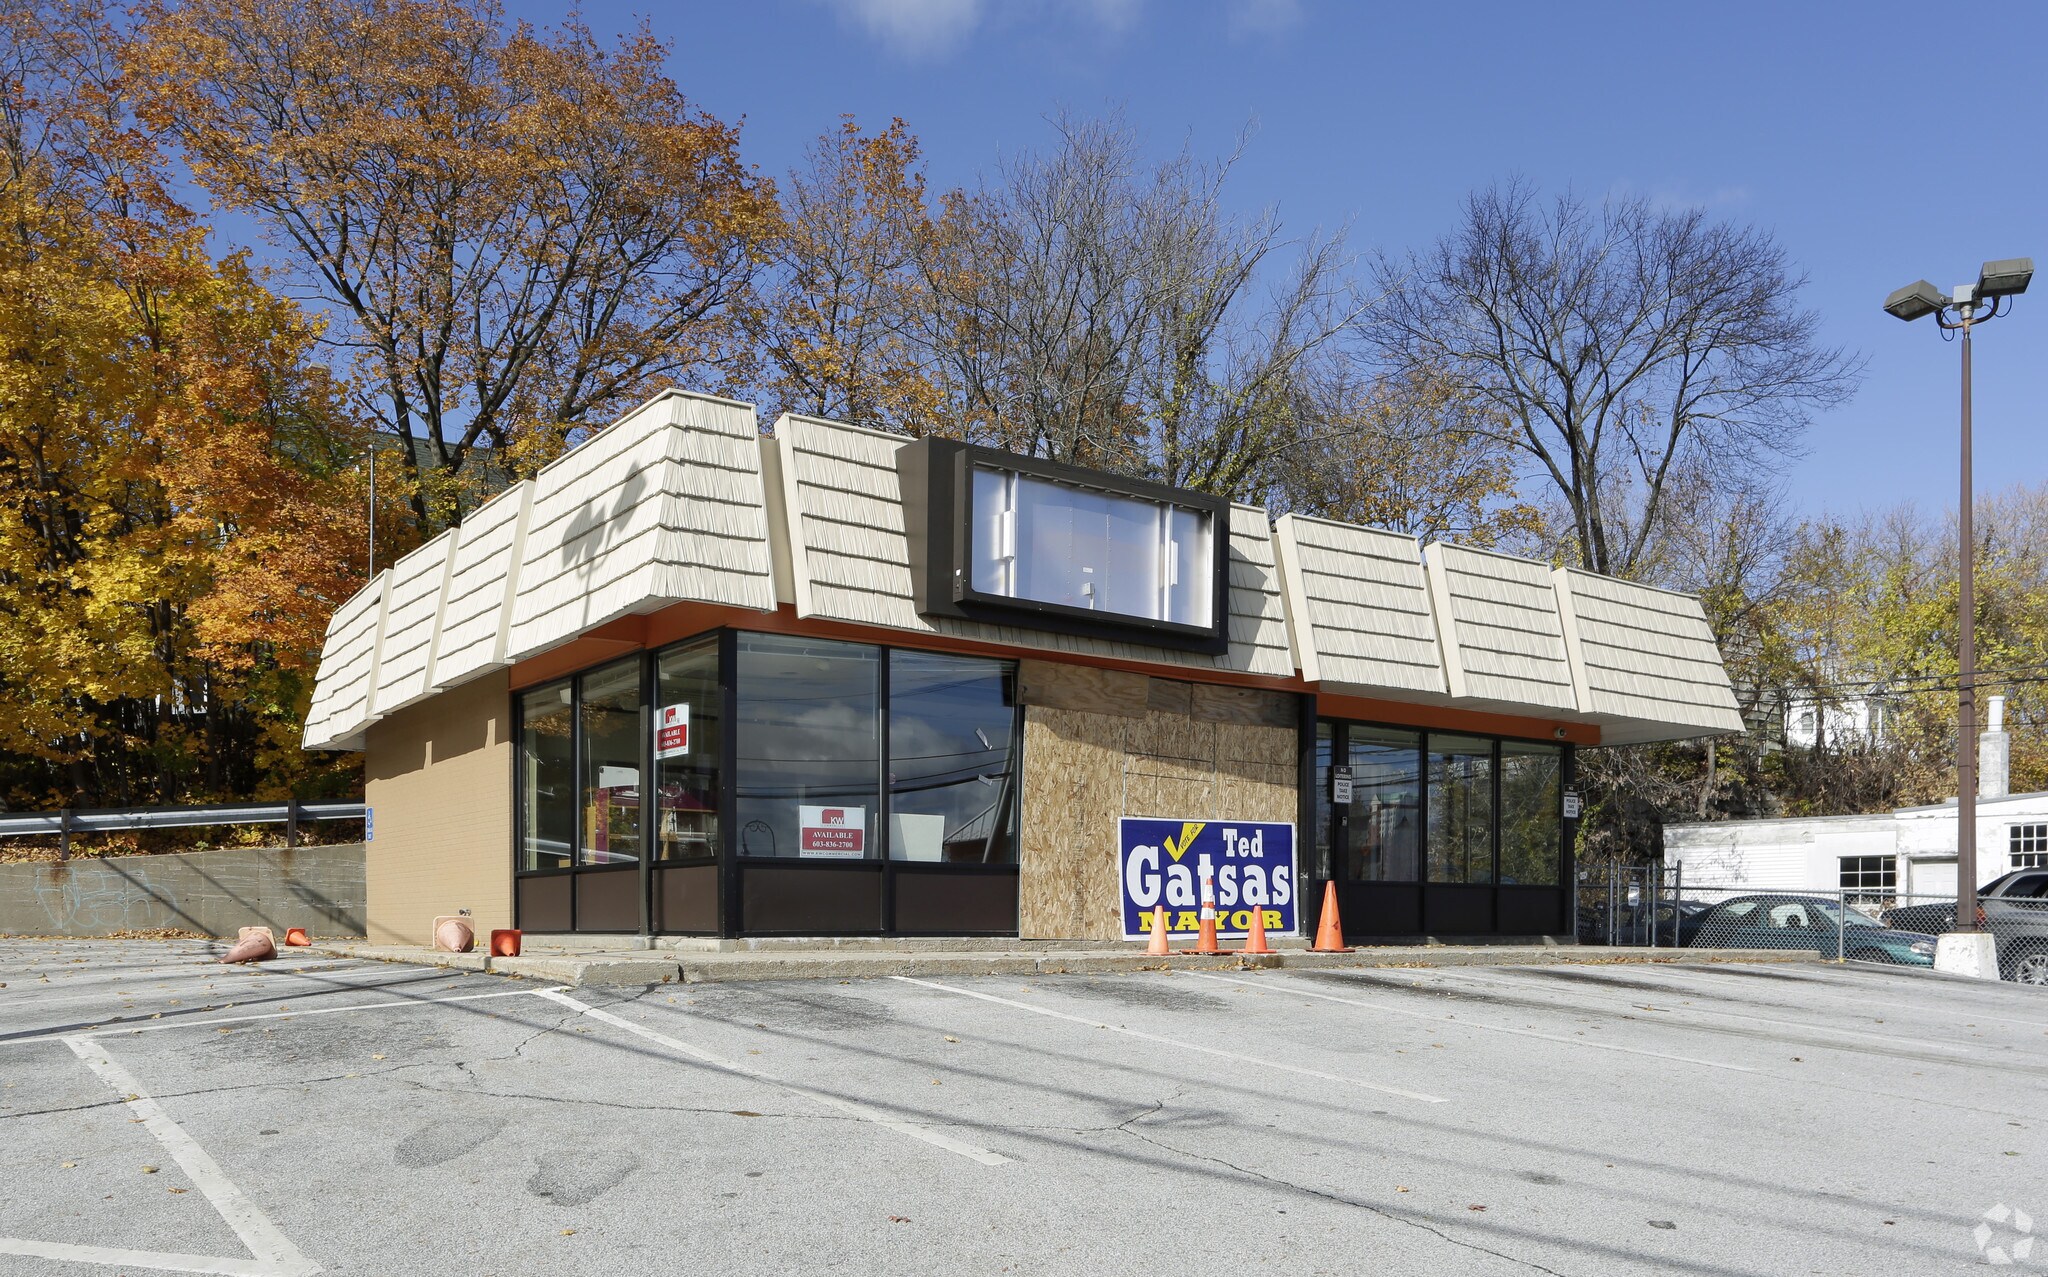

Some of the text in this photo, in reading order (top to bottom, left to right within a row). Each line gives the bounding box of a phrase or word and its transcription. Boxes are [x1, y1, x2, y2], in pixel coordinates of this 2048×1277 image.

[830, 817, 844, 825] KW
[812, 831, 854, 839] AVAILABLE
[1180, 823, 1199, 849] VOTE FOR
[1222, 828, 1263, 858] Ted
[1126, 845, 1291, 907] Gatsas
